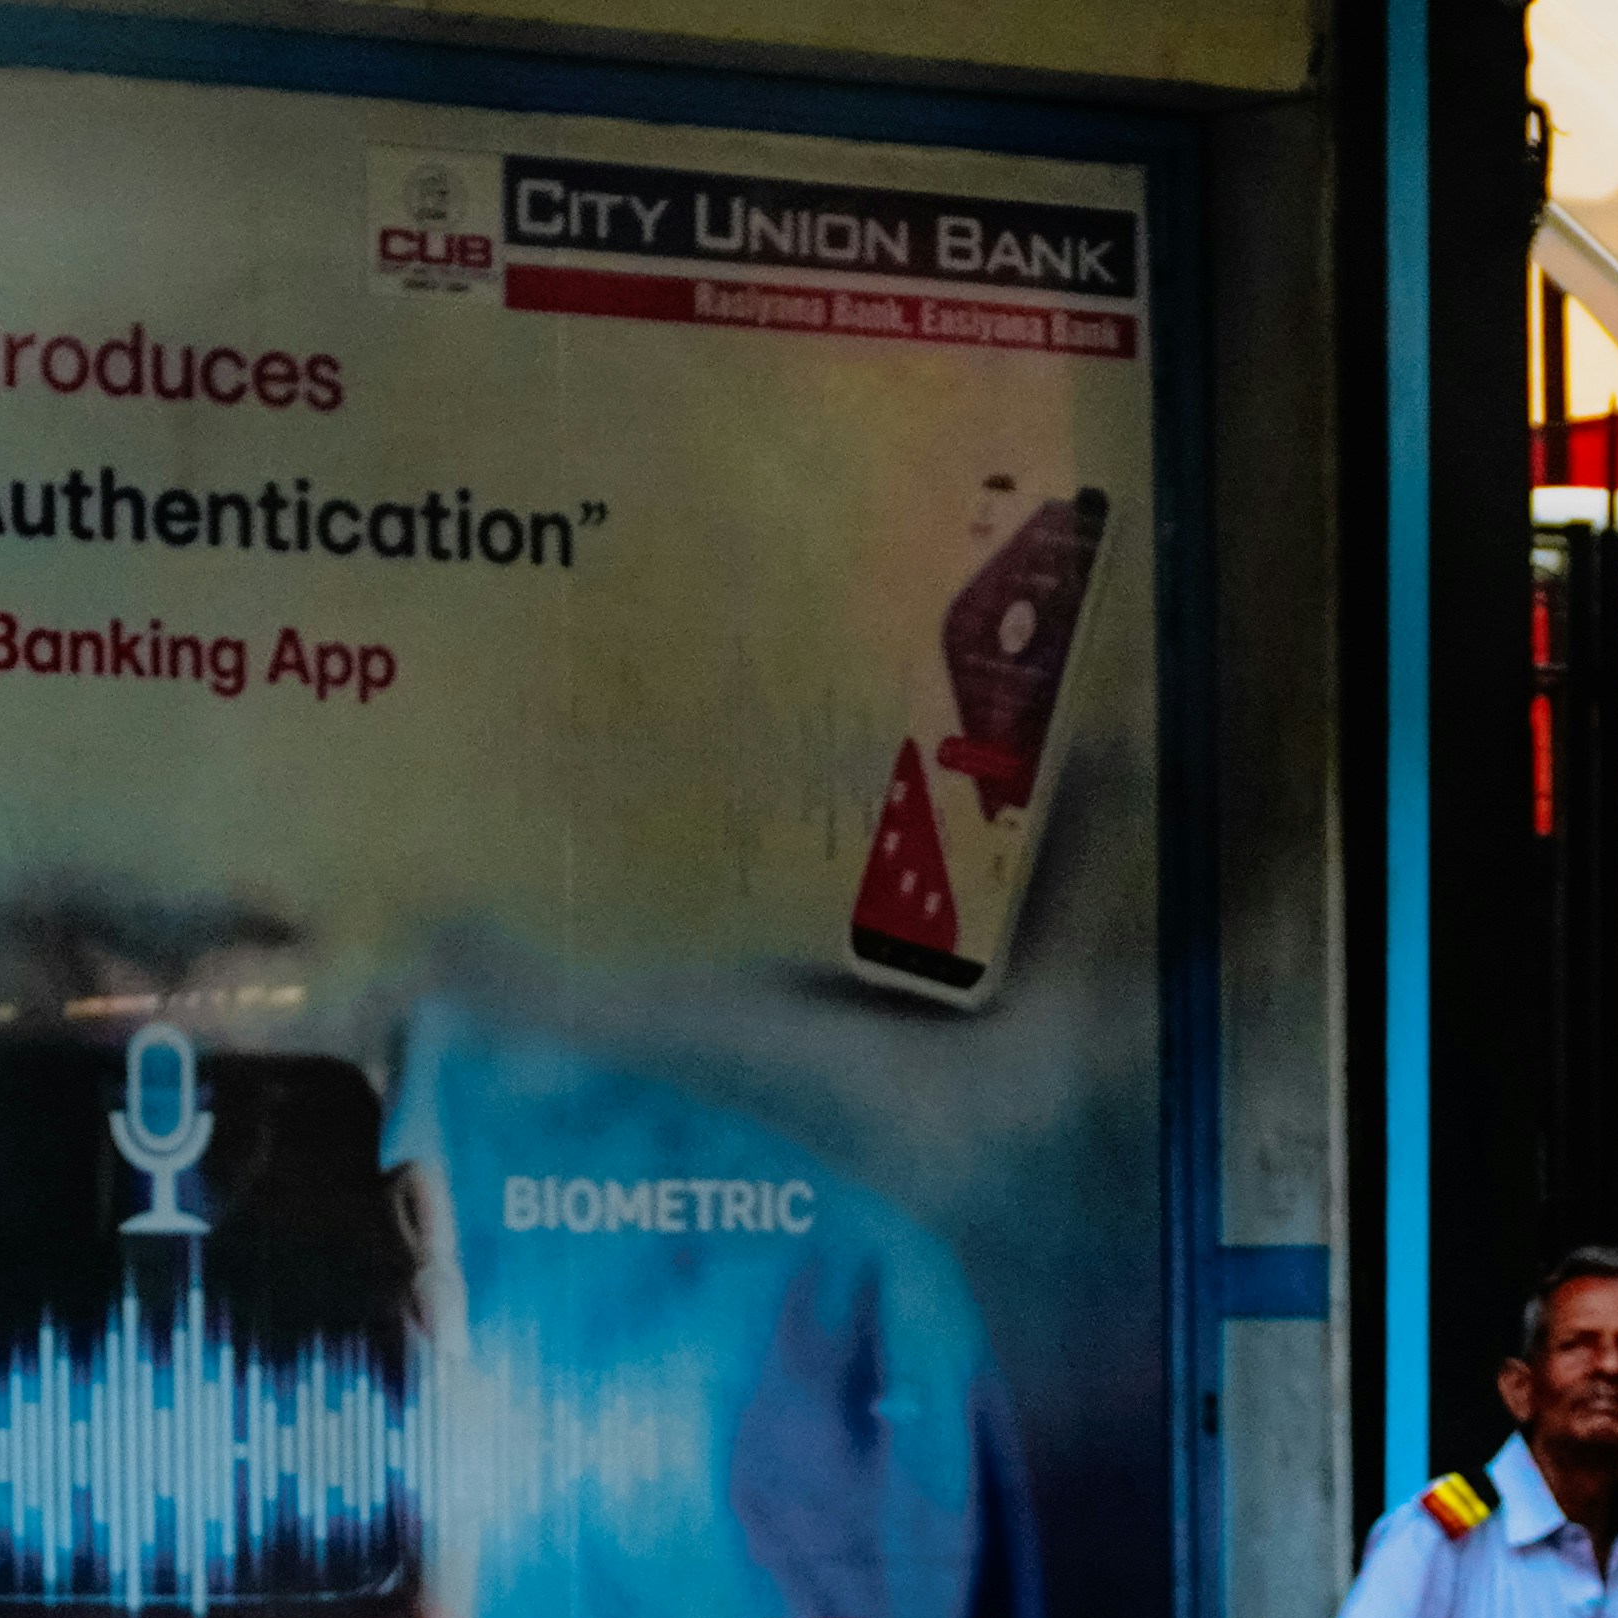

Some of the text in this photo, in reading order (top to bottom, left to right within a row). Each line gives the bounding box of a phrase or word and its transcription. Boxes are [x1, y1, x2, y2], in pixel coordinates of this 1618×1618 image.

[379, 227, 493, 269] CUB
[515, 178, 1117, 284] CITY UNION BANK
[267, 626, 397, 703] App
[502, 1176, 815, 1236] BIOMETRIC
